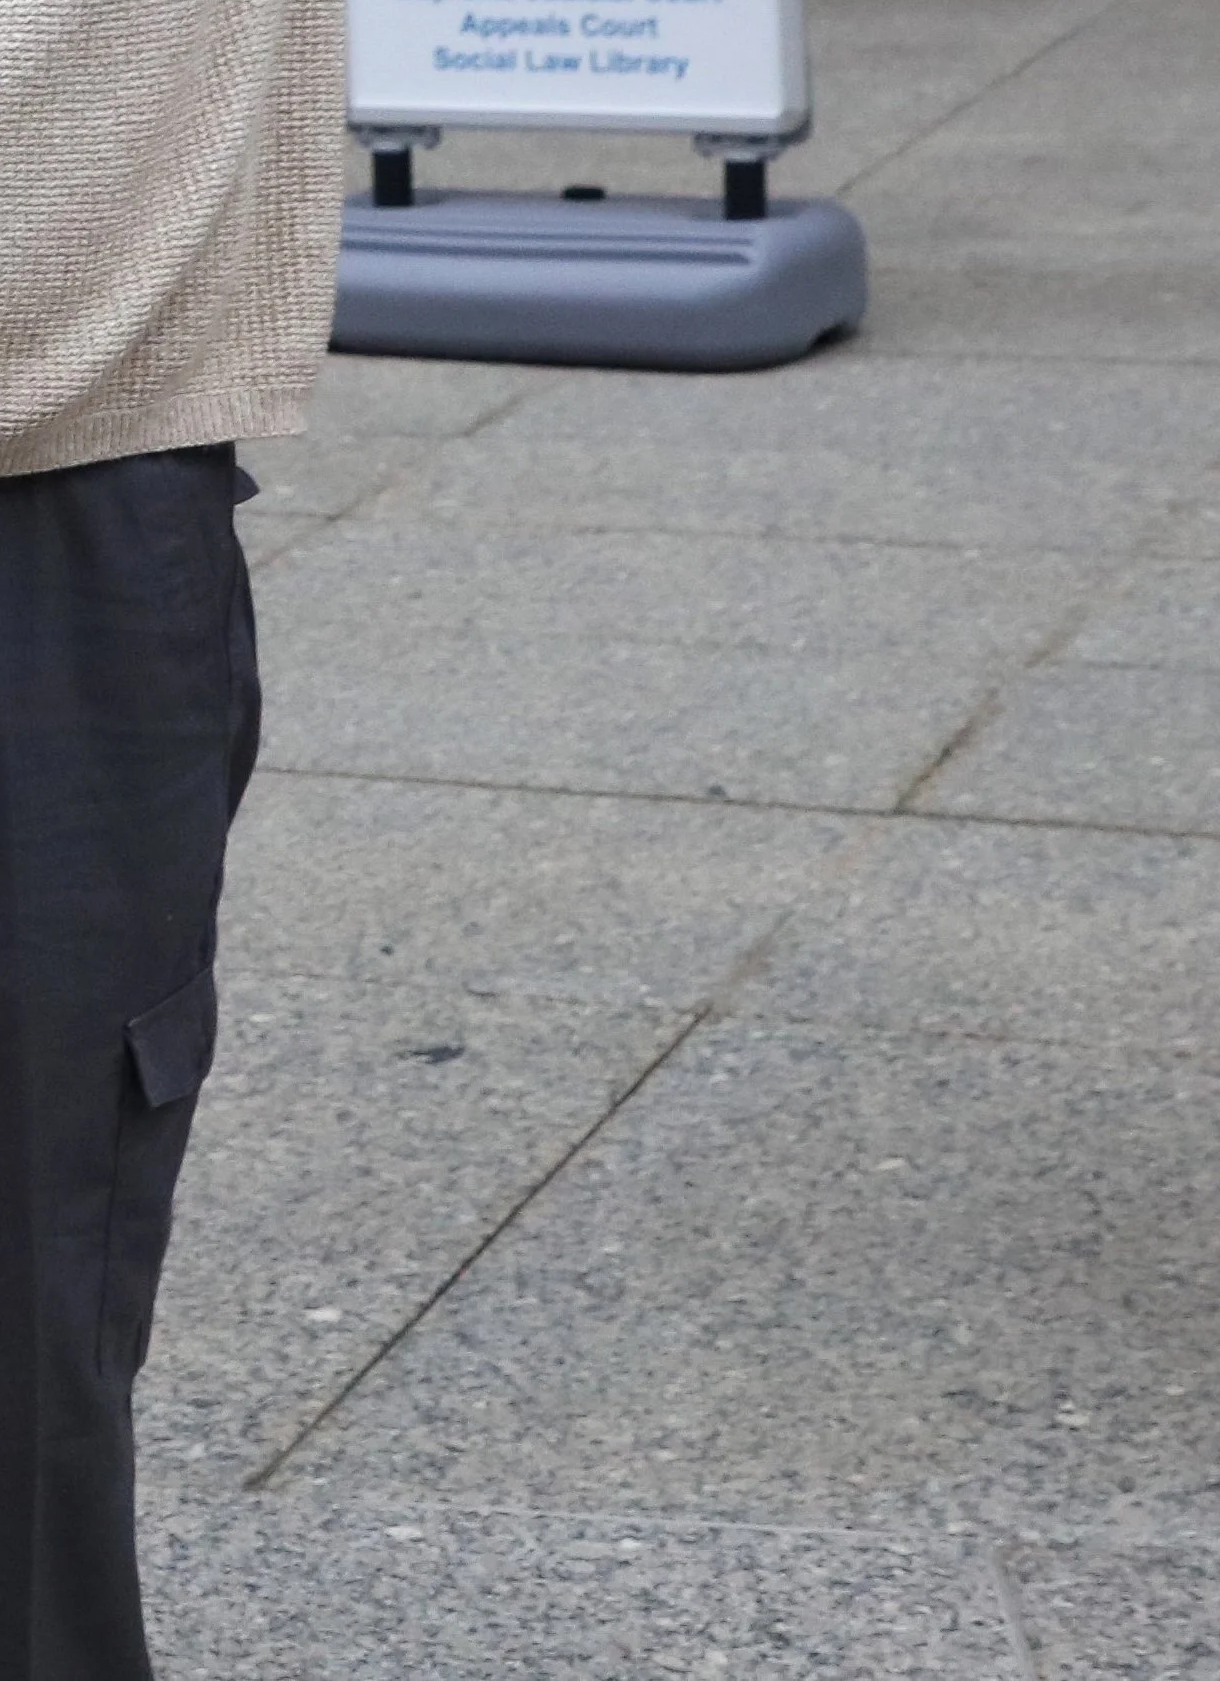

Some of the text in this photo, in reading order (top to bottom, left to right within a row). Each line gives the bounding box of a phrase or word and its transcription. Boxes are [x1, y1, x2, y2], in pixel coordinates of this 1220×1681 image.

[459, 12, 659, 39] Appeals Court
[432, 46, 690, 79] Social Law Library
